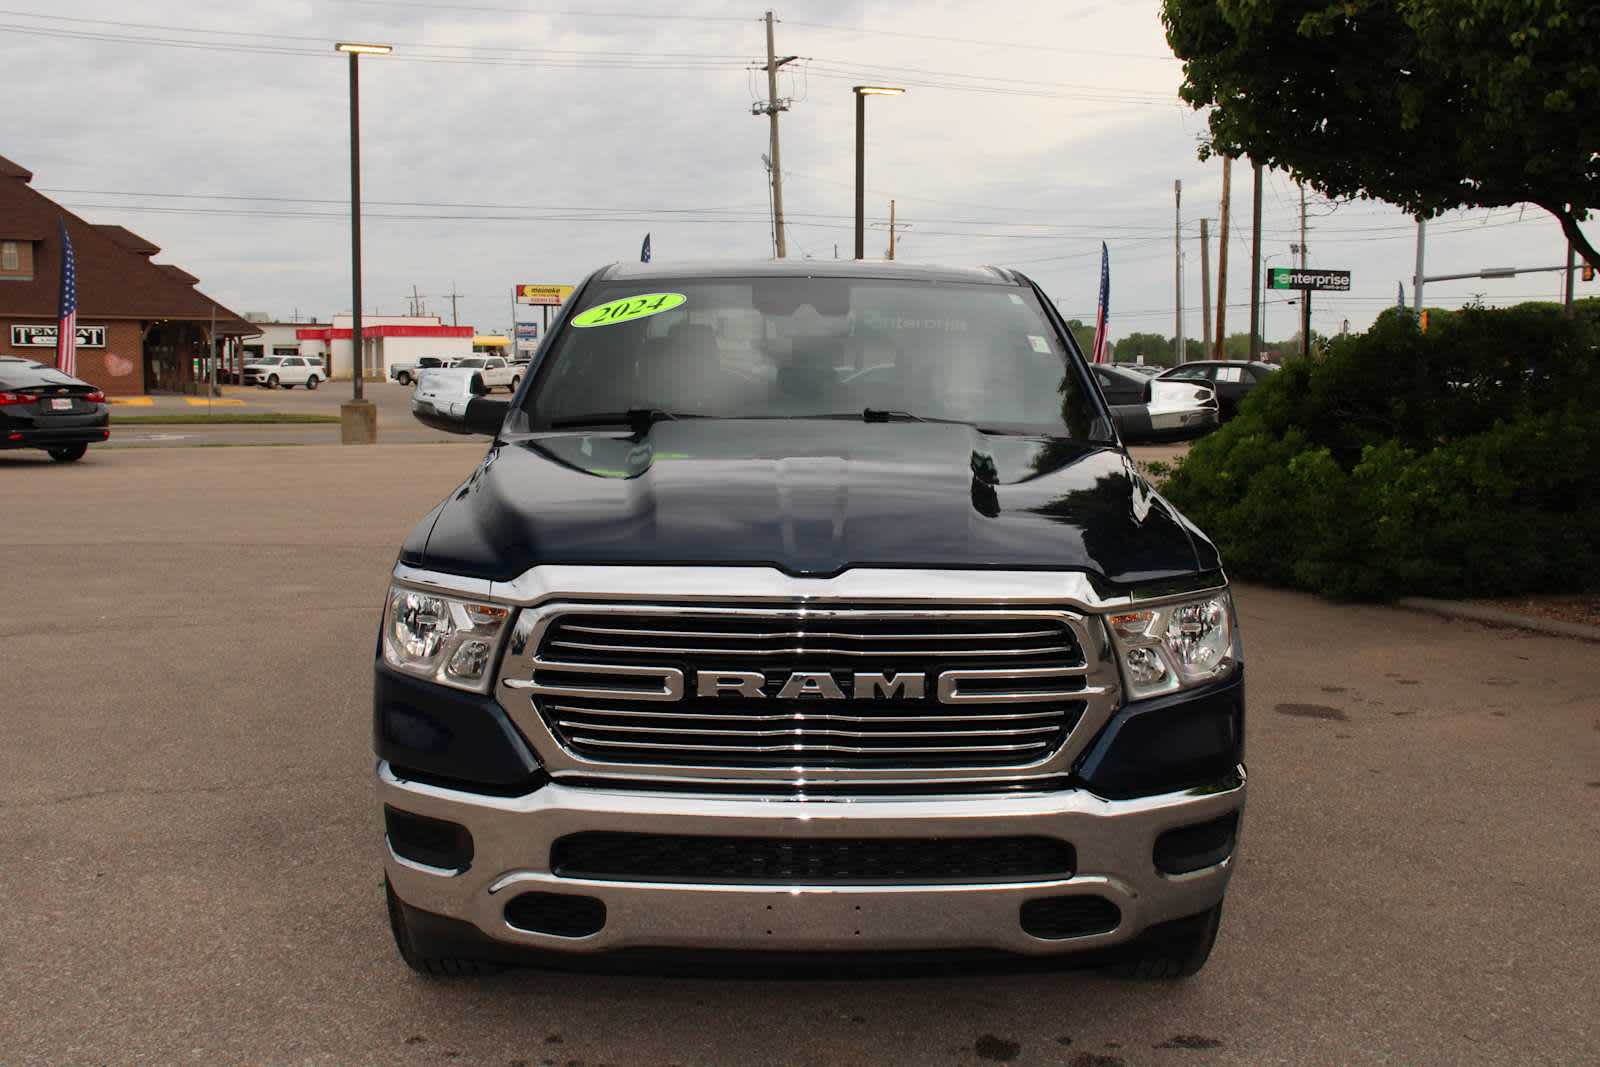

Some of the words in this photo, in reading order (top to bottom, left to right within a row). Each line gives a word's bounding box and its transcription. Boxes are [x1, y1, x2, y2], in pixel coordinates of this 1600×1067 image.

[1278, 272, 1350, 288] enterprise
[591, 295, 668, 324] 2024
[696, 669, 926, 699] RAM
